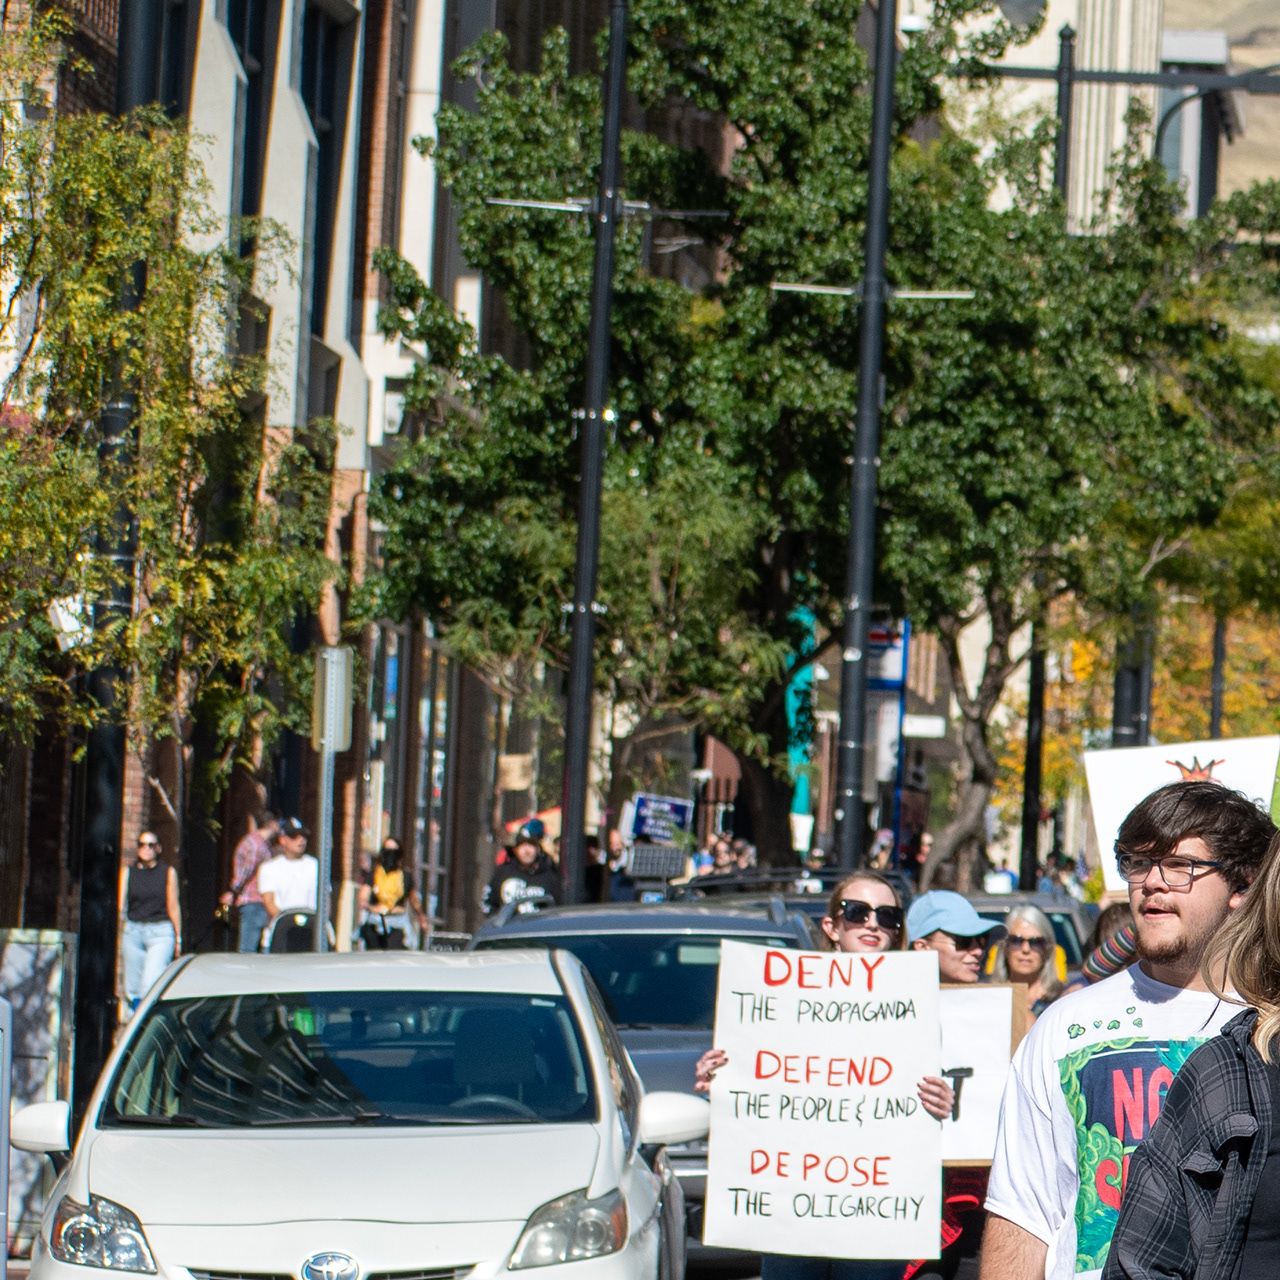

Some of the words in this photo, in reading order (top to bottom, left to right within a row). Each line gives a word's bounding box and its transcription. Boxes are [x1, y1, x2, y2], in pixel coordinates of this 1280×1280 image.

[763, 951, 886, 992] DENY
[731, 991, 778, 1024] THE
[797, 998, 917, 1024] PROPAGANDA
[755, 1050, 893, 1087] DEFEND
[729, 1090, 771, 1119] THE
[779, 1094, 852, 1123] PEOPLE
[854, 1094, 867, 1128] &
[873, 1096, 918, 1120] LAND
[750, 1149, 892, 1187] DEPOSE
[728, 1188, 773, 1217] THE
[793, 1193, 925, 1222] OLIGARCHY
